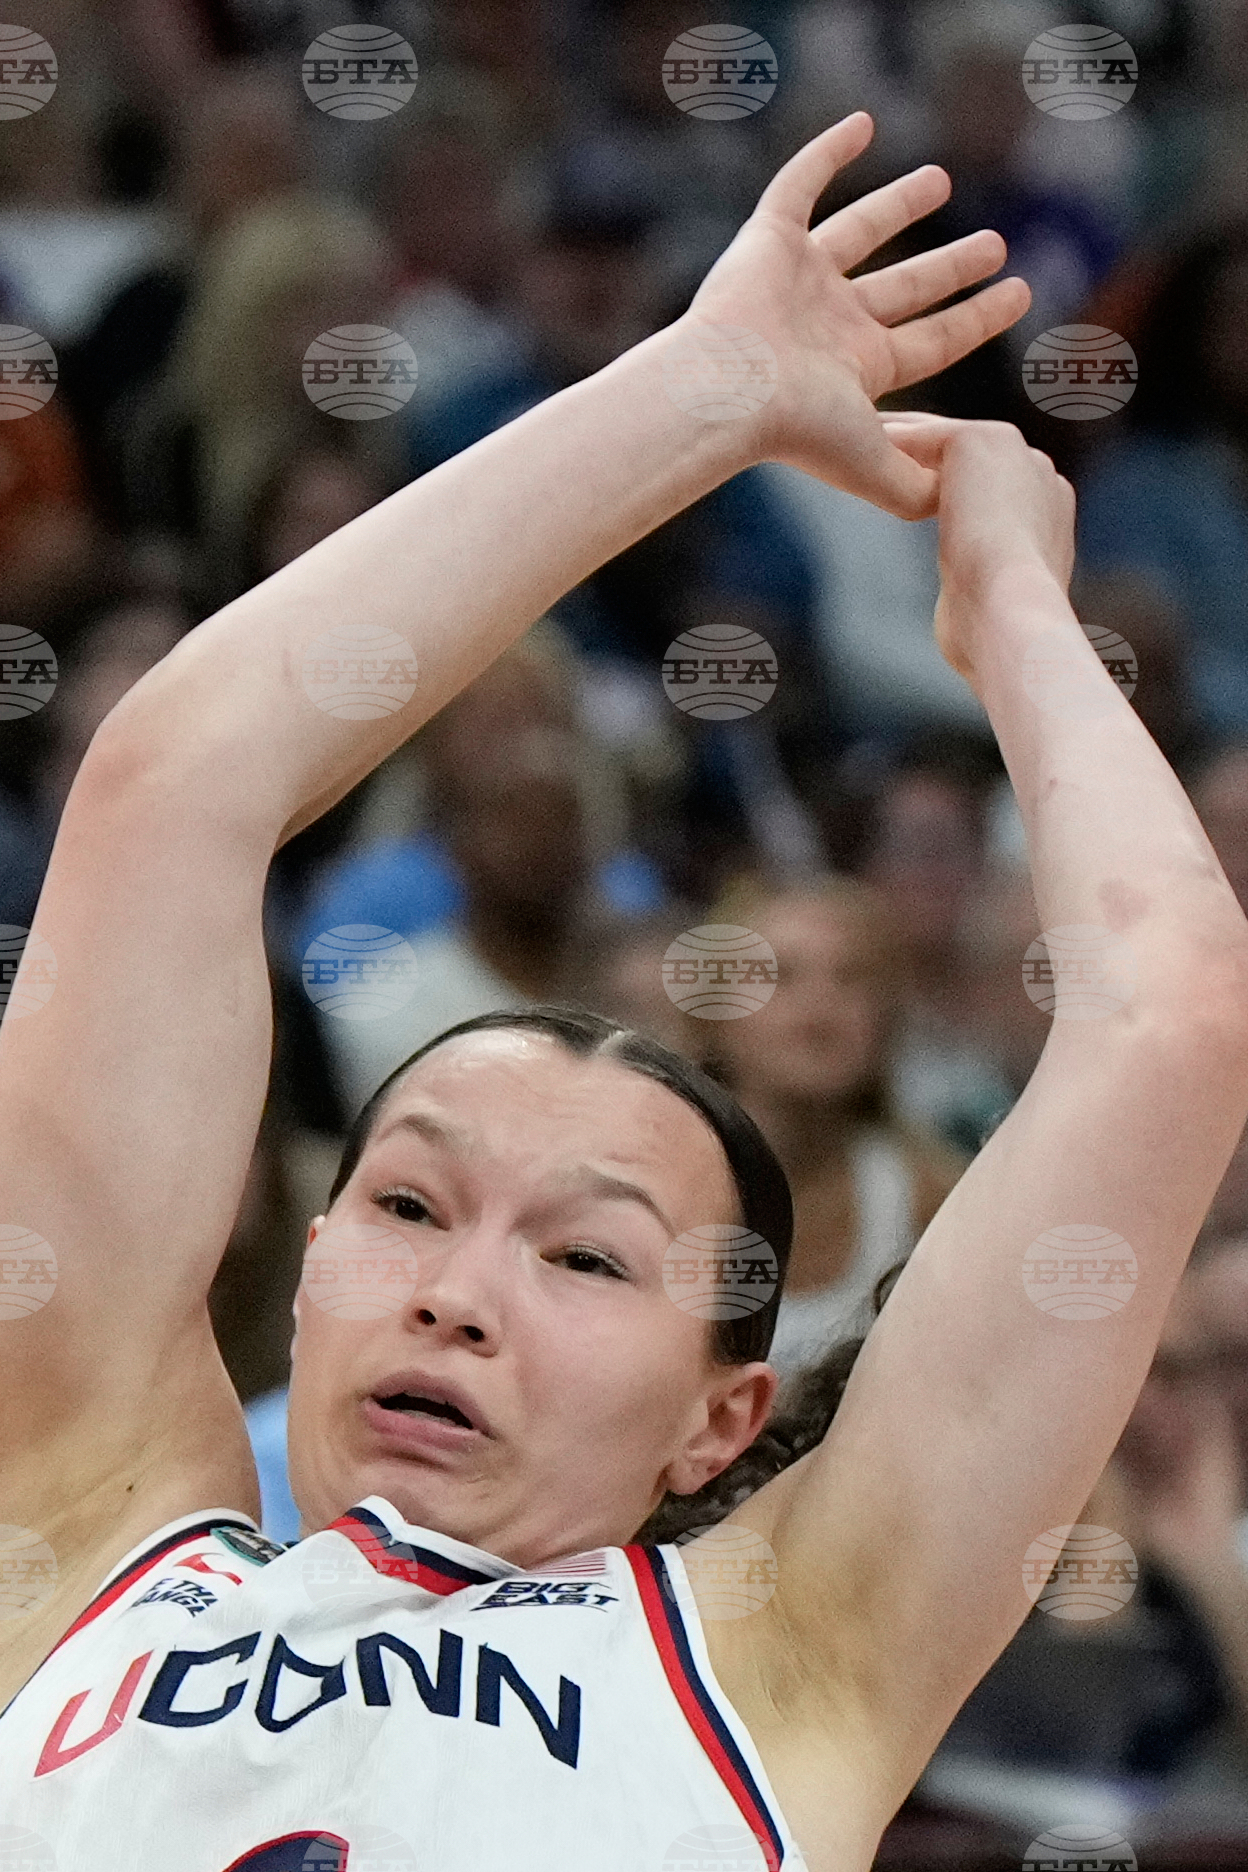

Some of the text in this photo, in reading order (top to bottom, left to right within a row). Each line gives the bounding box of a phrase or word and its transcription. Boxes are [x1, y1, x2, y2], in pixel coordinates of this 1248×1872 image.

[495, 1581, 594, 1594] BIG
[480, 1594, 620, 1607] EAST
[33, 1628, 583, 1778] UCONN
